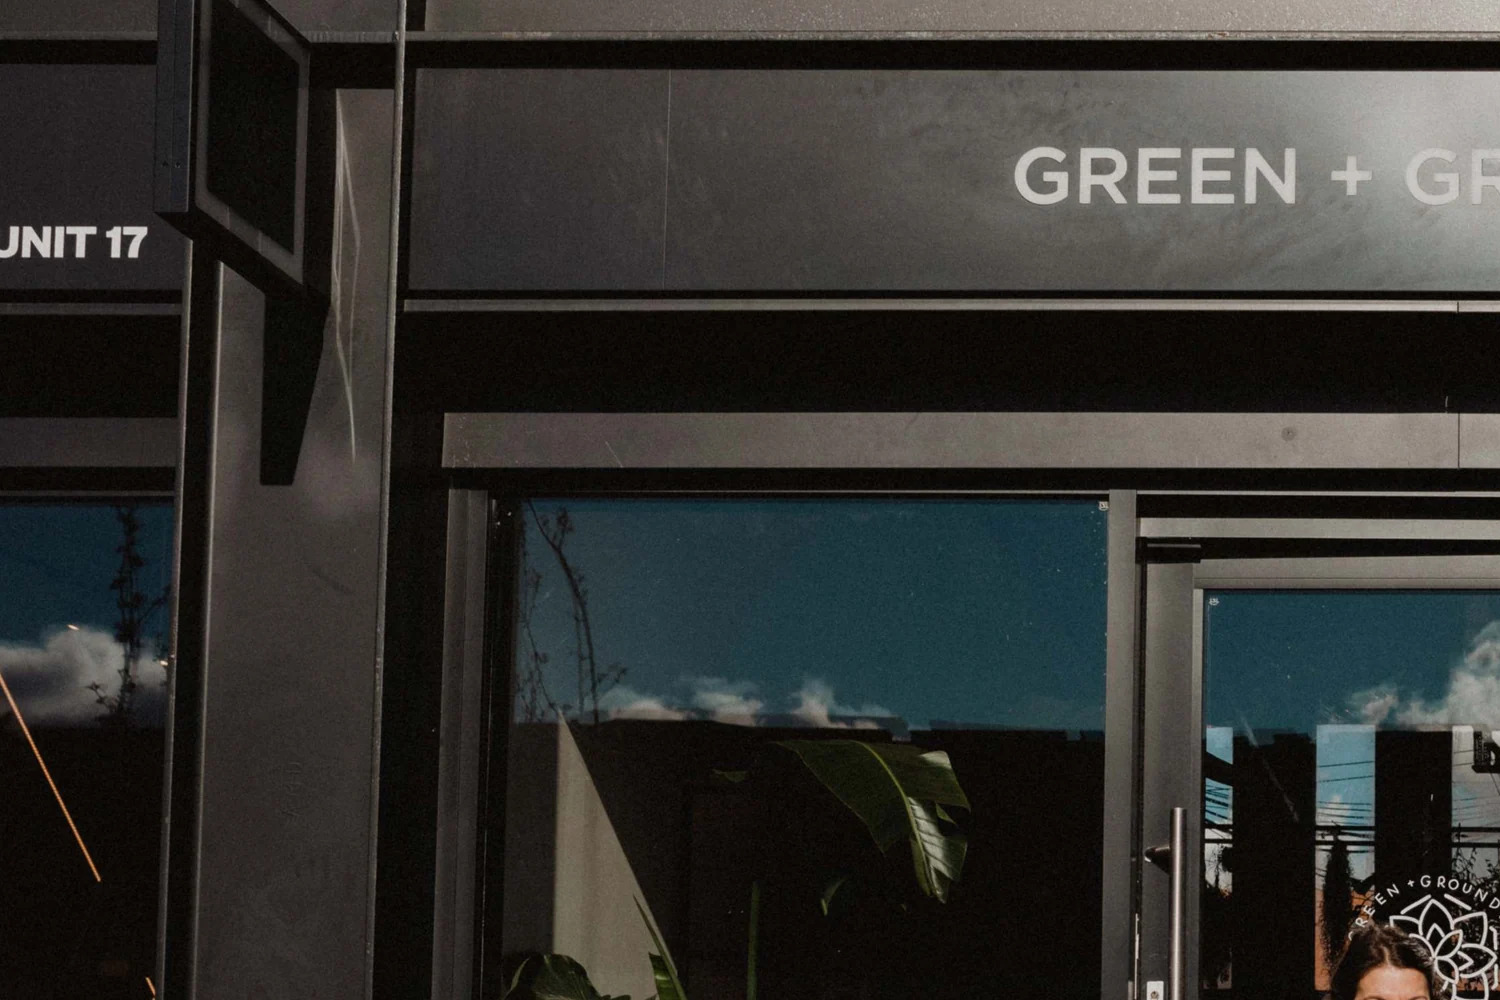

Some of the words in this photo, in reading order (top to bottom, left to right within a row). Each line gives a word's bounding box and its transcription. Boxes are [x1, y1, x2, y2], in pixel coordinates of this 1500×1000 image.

[1014, 146, 1296, 205] GREEN
[1330, 156, 1372, 195] +
[0, 226, 97, 258] UNIT
[105, 226, 148, 258] 17
[1348, 883, 1400, 941] REEN
